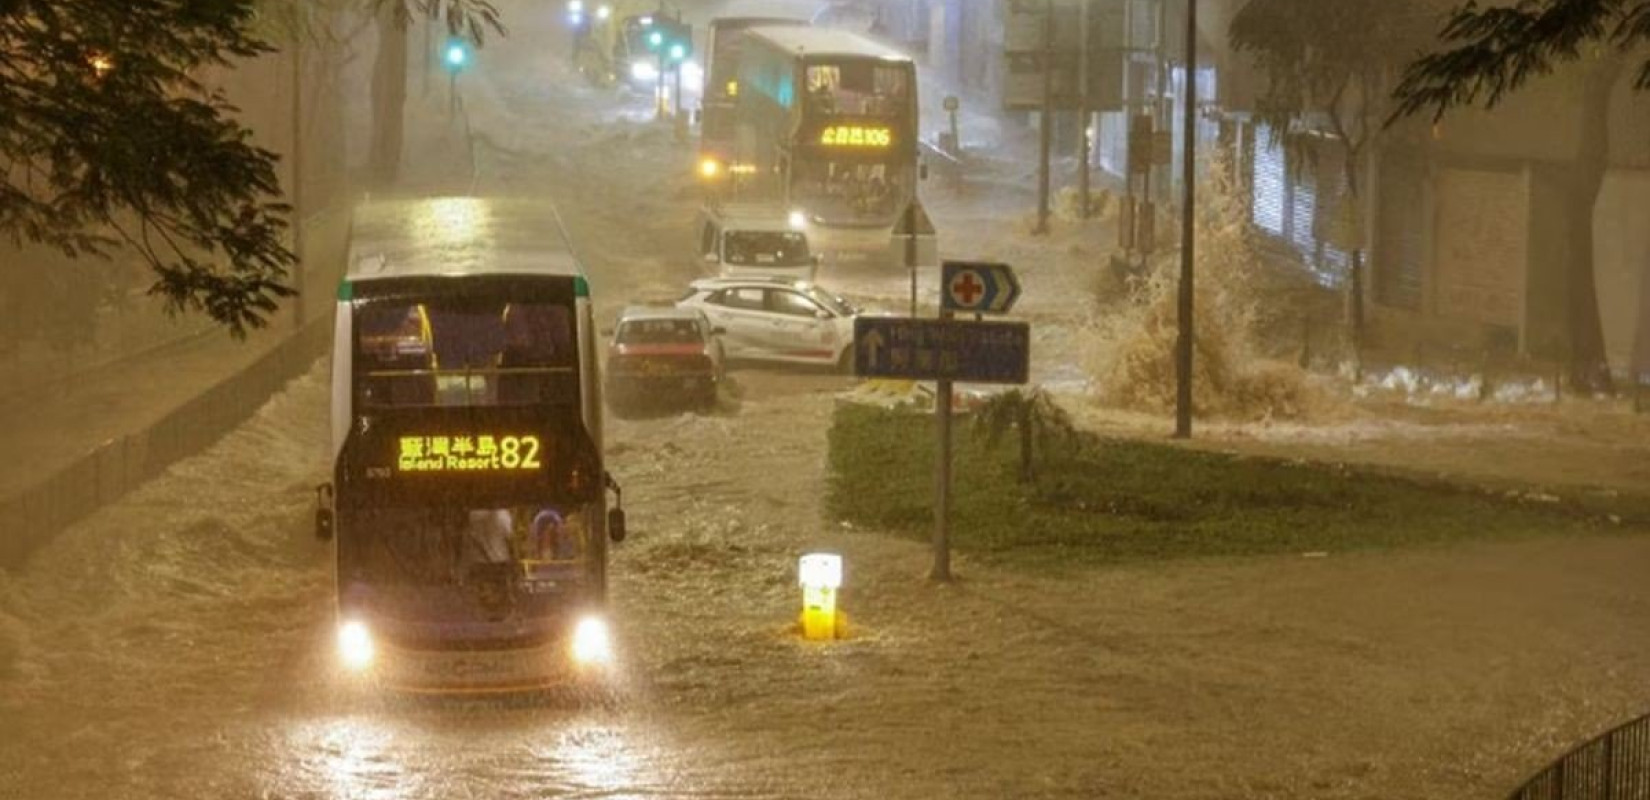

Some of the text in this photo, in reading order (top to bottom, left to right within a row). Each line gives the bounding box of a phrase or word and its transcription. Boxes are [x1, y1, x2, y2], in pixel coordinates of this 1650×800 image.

[864, 127, 890, 145] 106
[501, 436, 541, 469] 82
[399, 454, 500, 471] Island Resort
